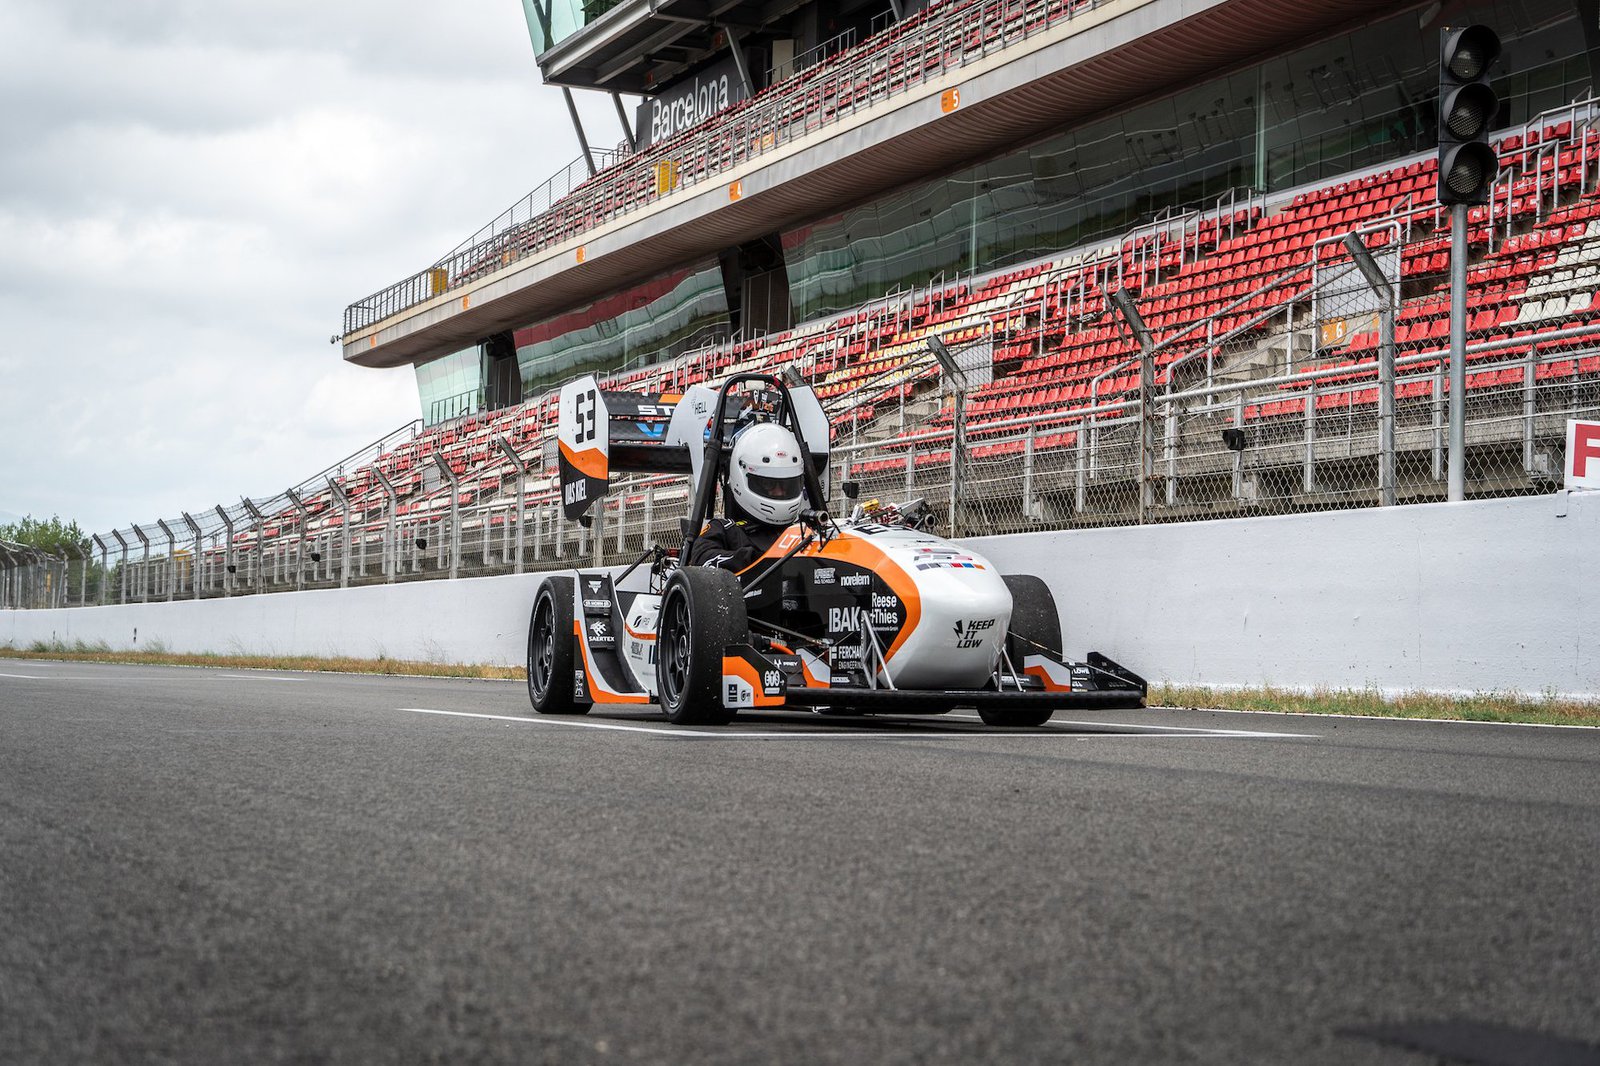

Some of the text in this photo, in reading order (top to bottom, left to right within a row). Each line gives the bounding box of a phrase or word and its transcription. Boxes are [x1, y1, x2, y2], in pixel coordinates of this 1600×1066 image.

[953, 90, 959, 107] 5
[651, 74, 728, 145] Barcelona
[736, 182, 742, 197] 4
[1336, 321, 1343, 338] 6
[576, 389, 595, 444] 53
[871, 592, 897, 608] Reese
[828, 606, 861, 632] IBAK
[870, 608, 898, 624] +Thies
[967, 619, 995, 630] KEEP
[964, 630, 977, 640] IT
[956, 639, 983, 648] LOW
[838, 645, 862, 659] FERCHA
